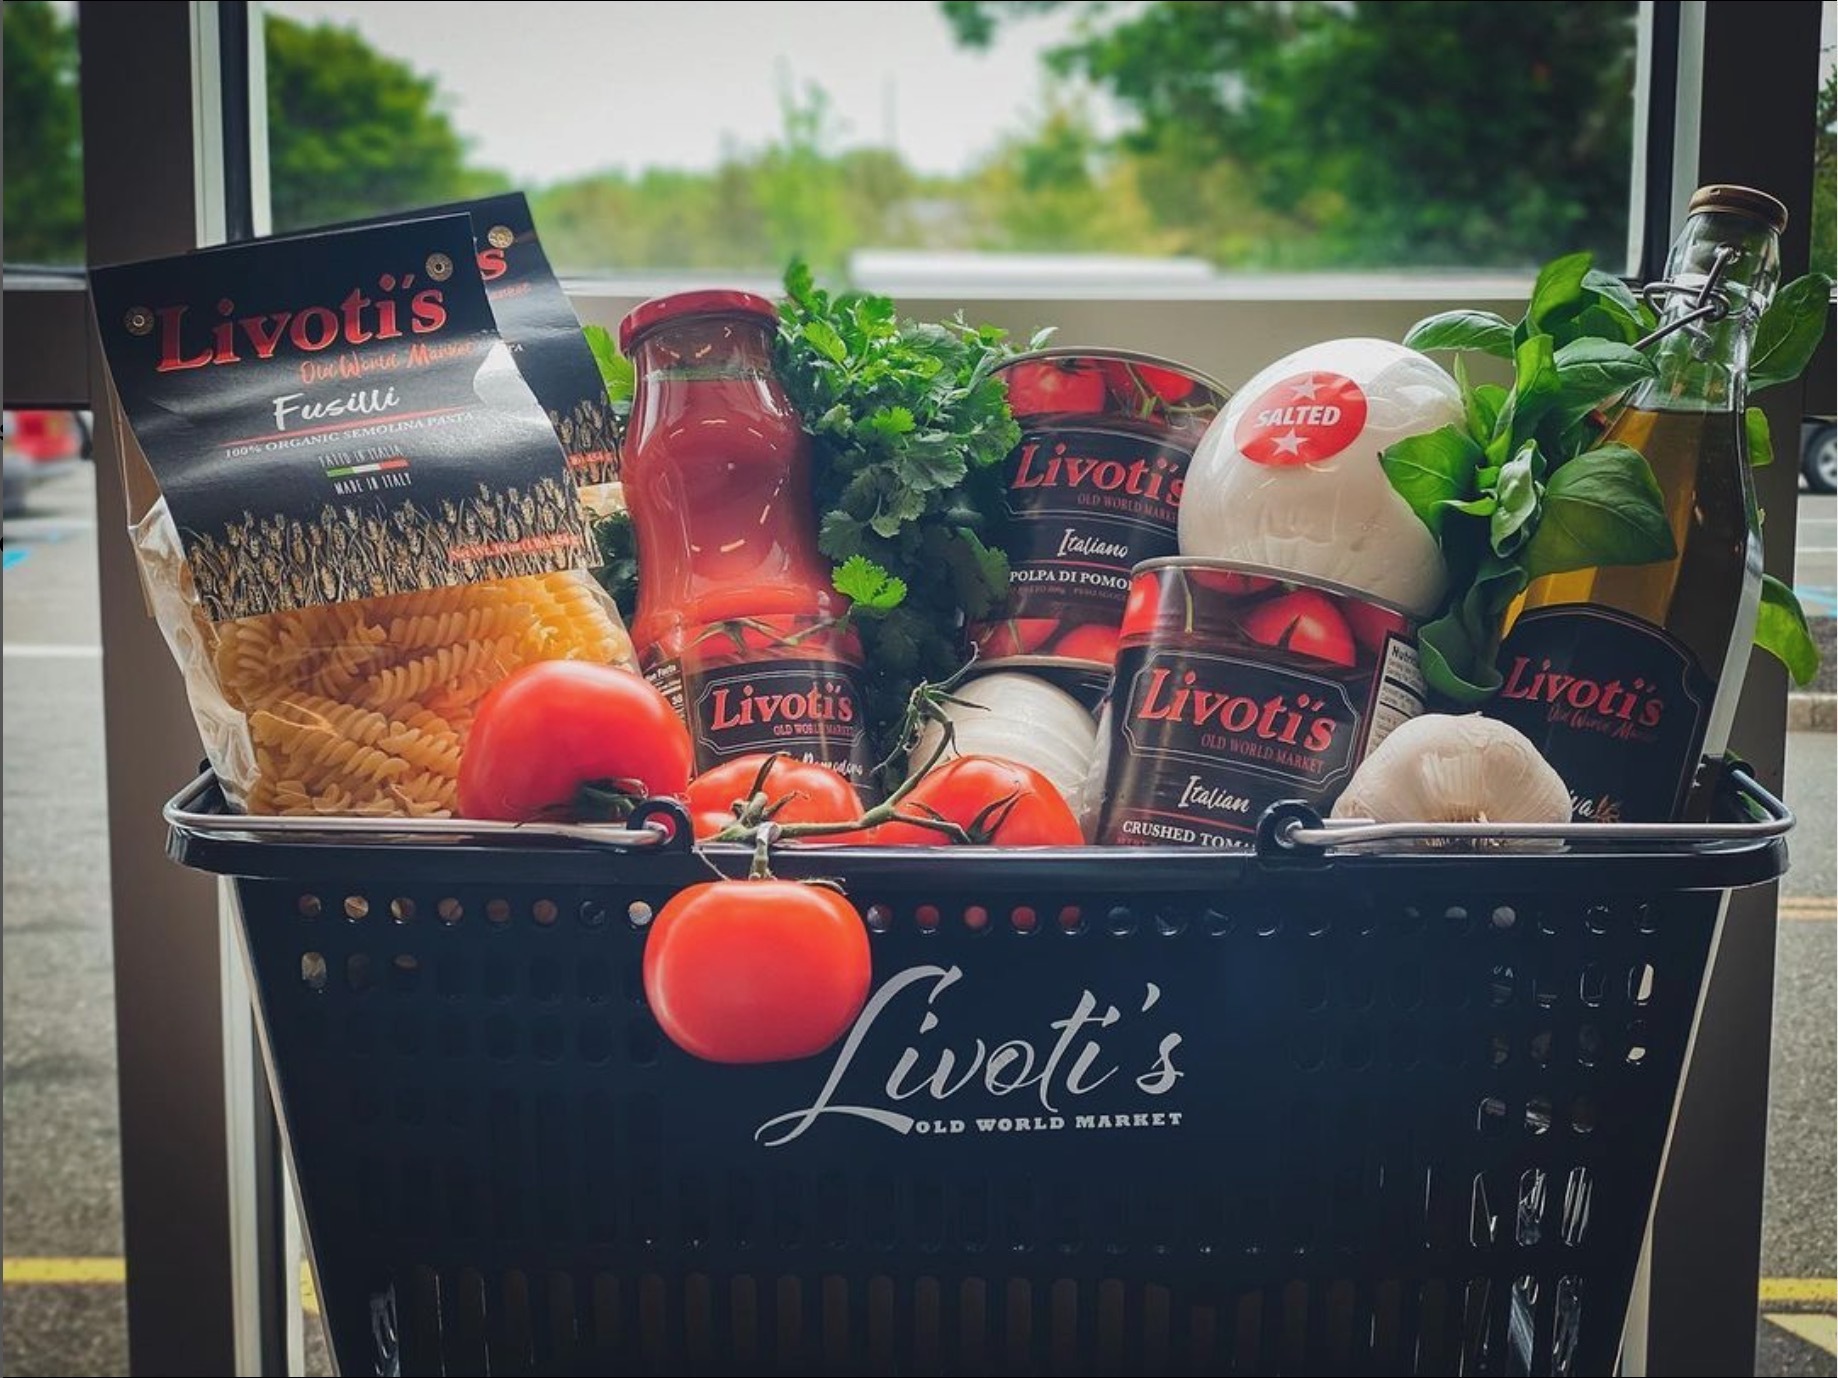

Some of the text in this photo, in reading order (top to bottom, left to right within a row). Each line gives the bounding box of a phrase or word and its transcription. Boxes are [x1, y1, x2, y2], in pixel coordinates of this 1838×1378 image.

[155, 272, 448, 373] Livoti's
[273, 386, 400, 432] Fusilli
[1254, 404, 1342, 427] SALTED
[226, 411, 474, 459] 100% ORGANIC SEMOLINA PASTA
[367, 444, 405, 461] ITALIA
[333, 472, 412, 495] MADE IN ITALY
[1011, 442, 1184, 507] Livoti's
[1077, 491, 1100, 506] OLD
[1103, 494, 1143, 513] WORLD
[1057, 528, 1129, 558] Italiano
[1009, 569, 1057, 583] POLPA
[1059, 571, 1077, 583] DI
[710, 681, 853, 731] Livoti's
[1136, 667, 1337, 752] Livoti's
[1501, 656, 1664, 727] Livoti's
[773, 724, 794, 736] OLD
[1201, 733, 1325, 774] OLD WORLD MARKET
[1178, 775, 1251, 813] Italian
[1122, 820, 1197, 843] CRUSHED
[754, 965, 1185, 1146] Livoti's
[915, 1112, 1183, 1134] OLD WORLD MARKET
